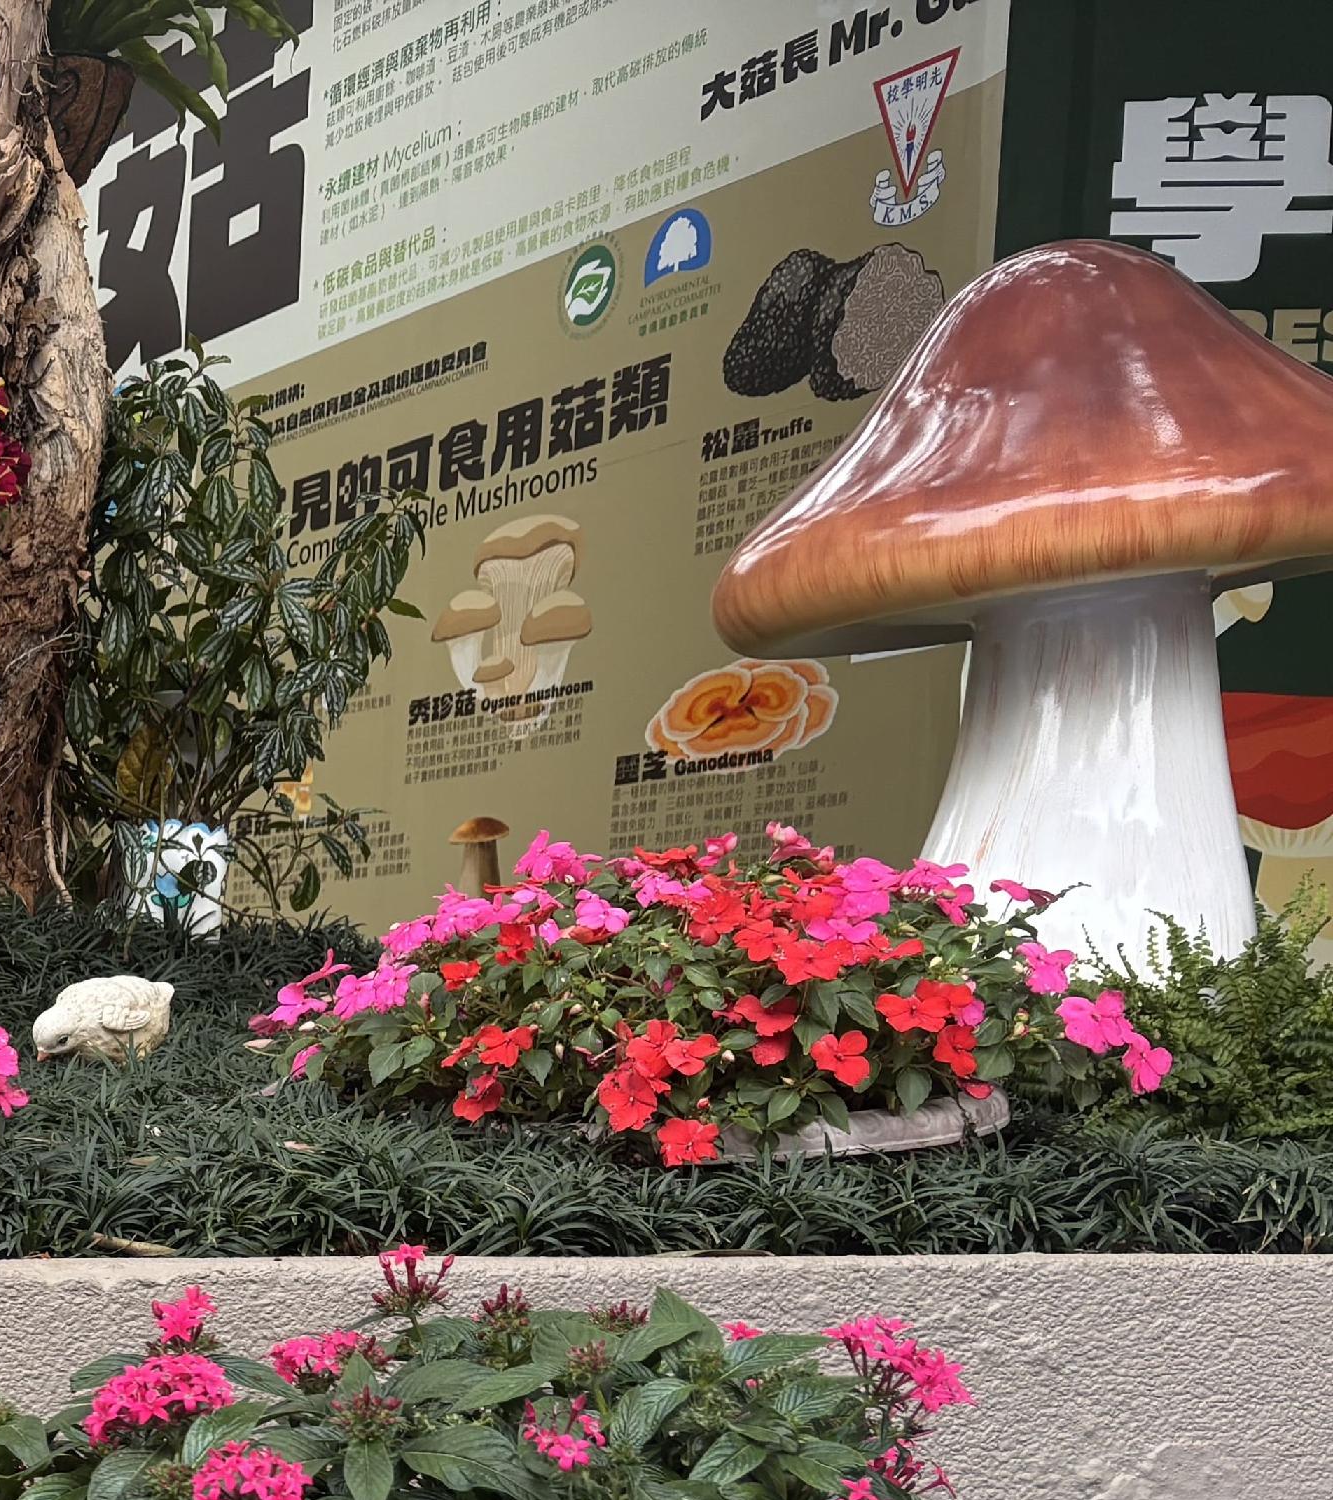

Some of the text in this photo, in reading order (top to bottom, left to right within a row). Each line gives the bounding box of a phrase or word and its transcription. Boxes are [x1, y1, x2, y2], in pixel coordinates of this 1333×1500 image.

[700, 29, 820, 122] 大菇長
[828, 8, 904, 67] Mr.
[1109, 92, 1333, 283] 學
[275, 352, 673, 541] 見的可食用菇類
[286, 538, 337, 571] Com
[455, 456, 598, 523] Mushrooms
[408, 687, 478, 727] 秀珍菇
[480, 694, 523, 714] Oyster
[524, 680, 594, 704] mushroom
[674, 749, 773, 777] Ganoderma
